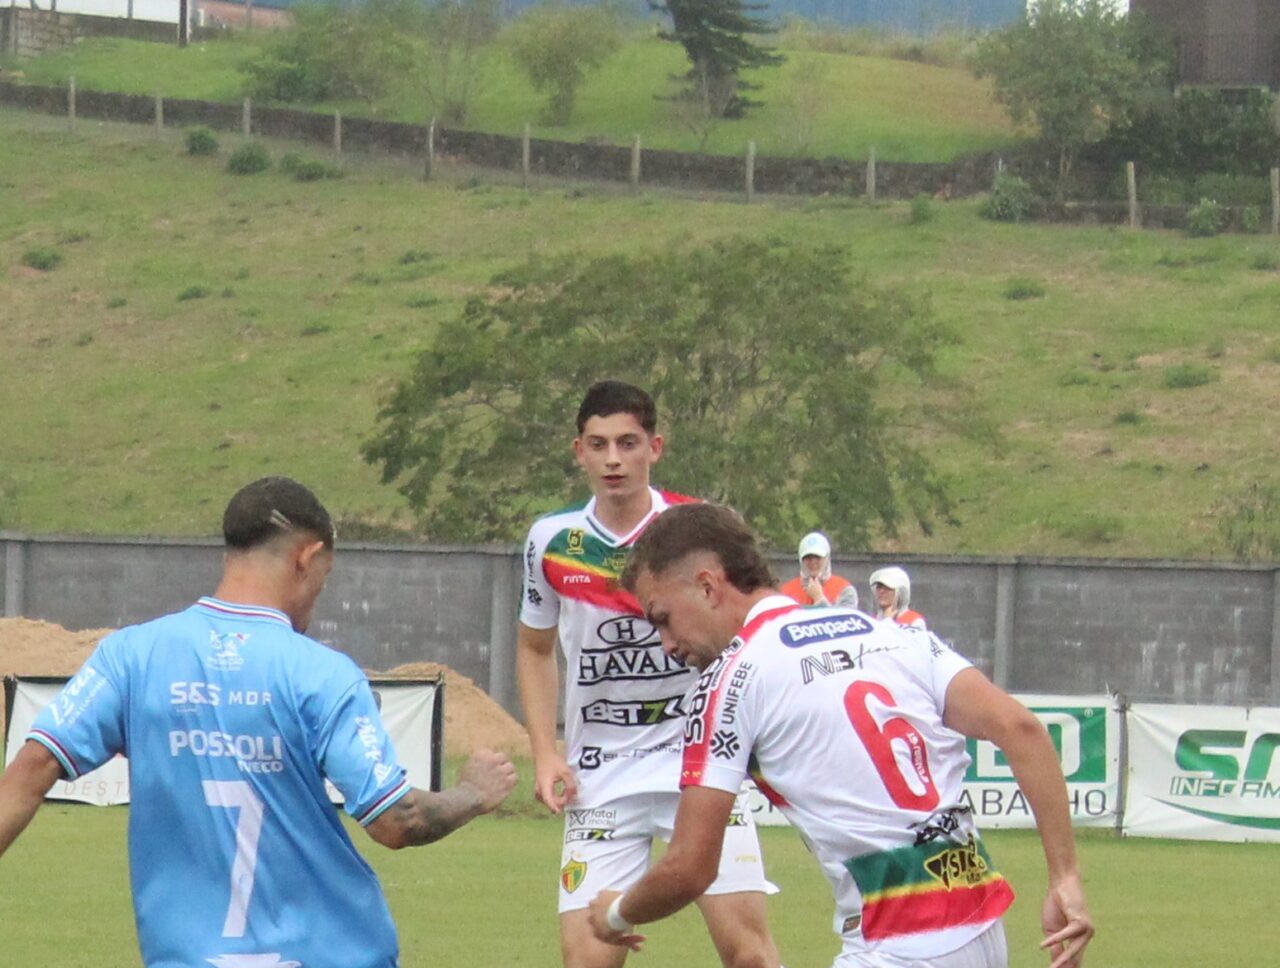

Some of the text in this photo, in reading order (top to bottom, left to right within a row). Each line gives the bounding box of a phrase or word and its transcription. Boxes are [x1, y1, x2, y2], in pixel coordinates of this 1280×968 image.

[615, 620, 636, 640] H
[786, 617, 867, 642] Bompack
[579, 651, 686, 680] HAVAN
[170, 681, 220, 706] S&S
[721, 661, 752, 725] UNIFEBE
[168, 729, 282, 761] POSSOLI
[843, 680, 940, 812] 6
[202, 780, 264, 938] 7
